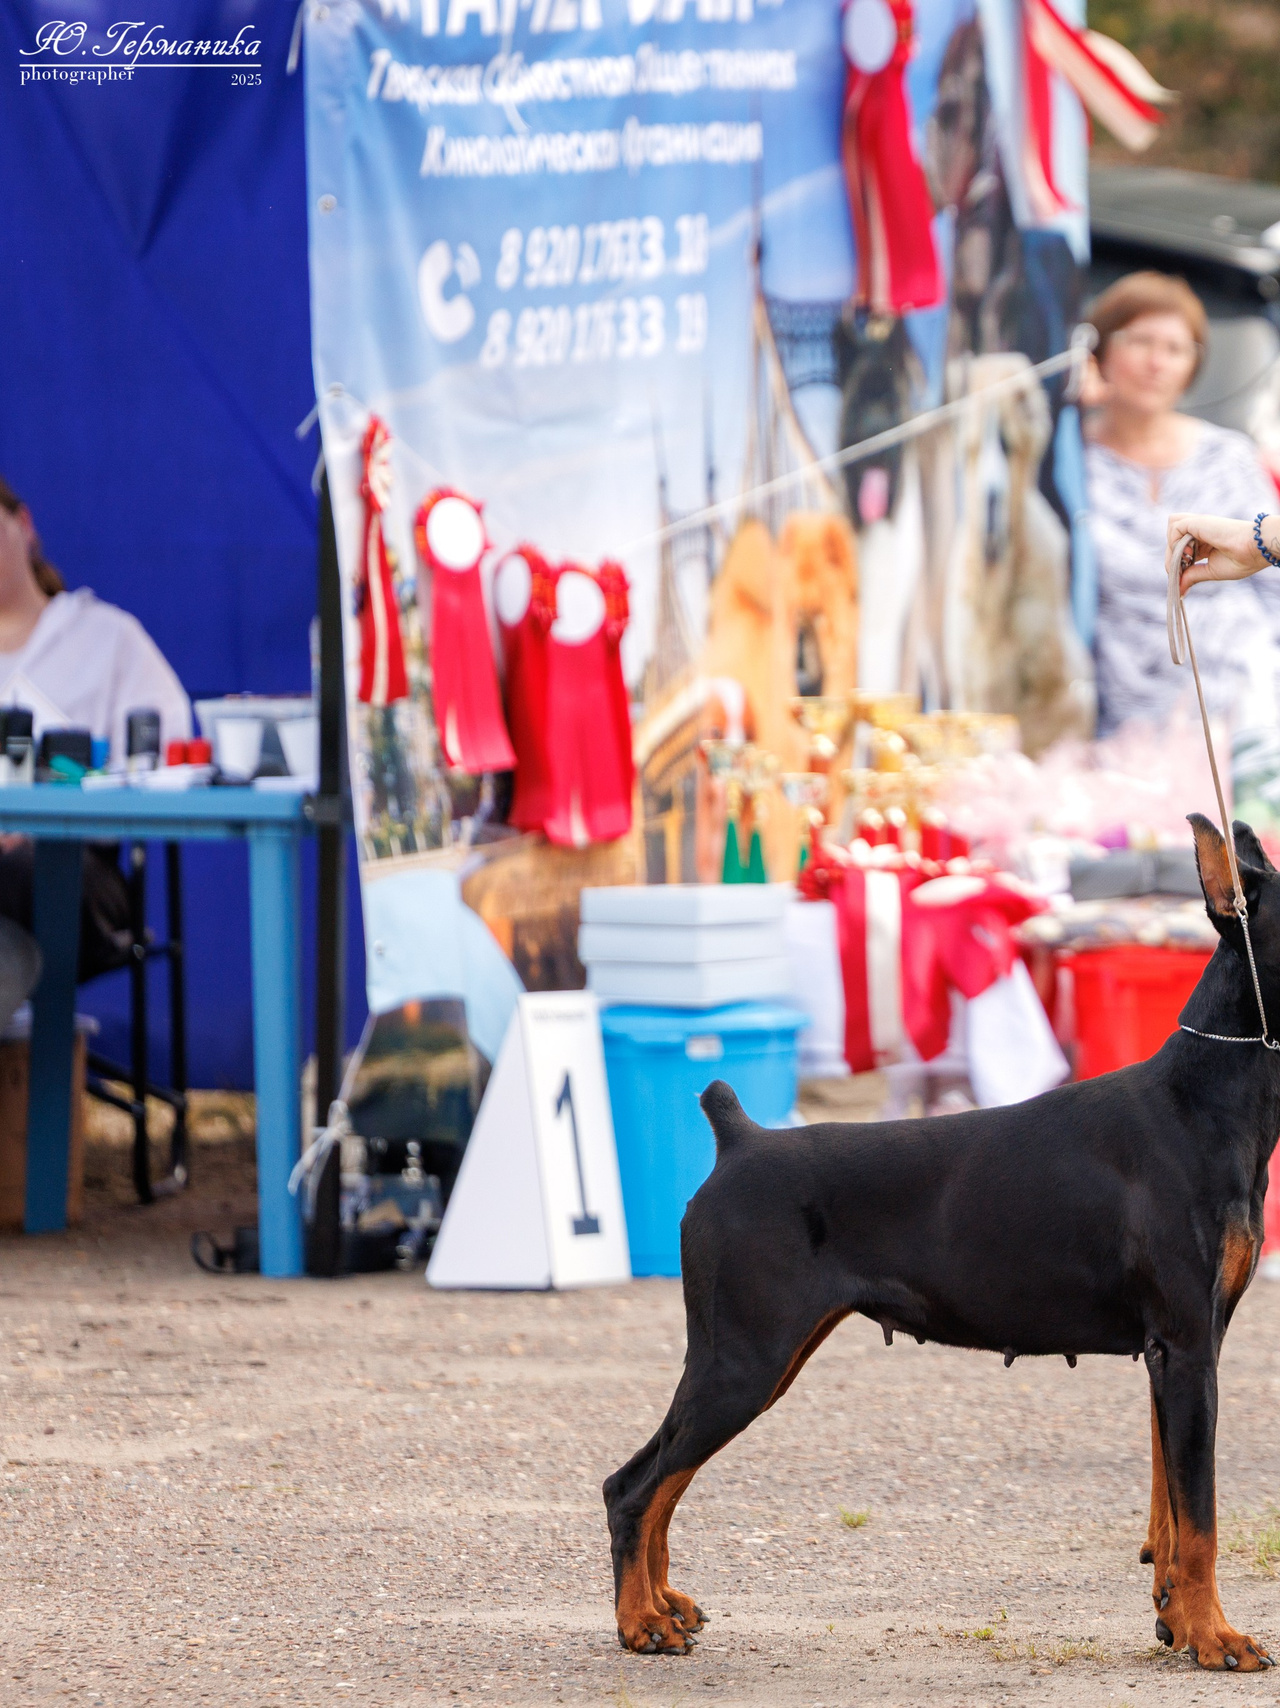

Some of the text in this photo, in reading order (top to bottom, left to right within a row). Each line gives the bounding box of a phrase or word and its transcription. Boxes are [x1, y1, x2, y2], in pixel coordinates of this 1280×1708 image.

[495, 227, 523, 290] 8
[479, 307, 512, 369] 8
[554, 1066, 601, 1236] 1
